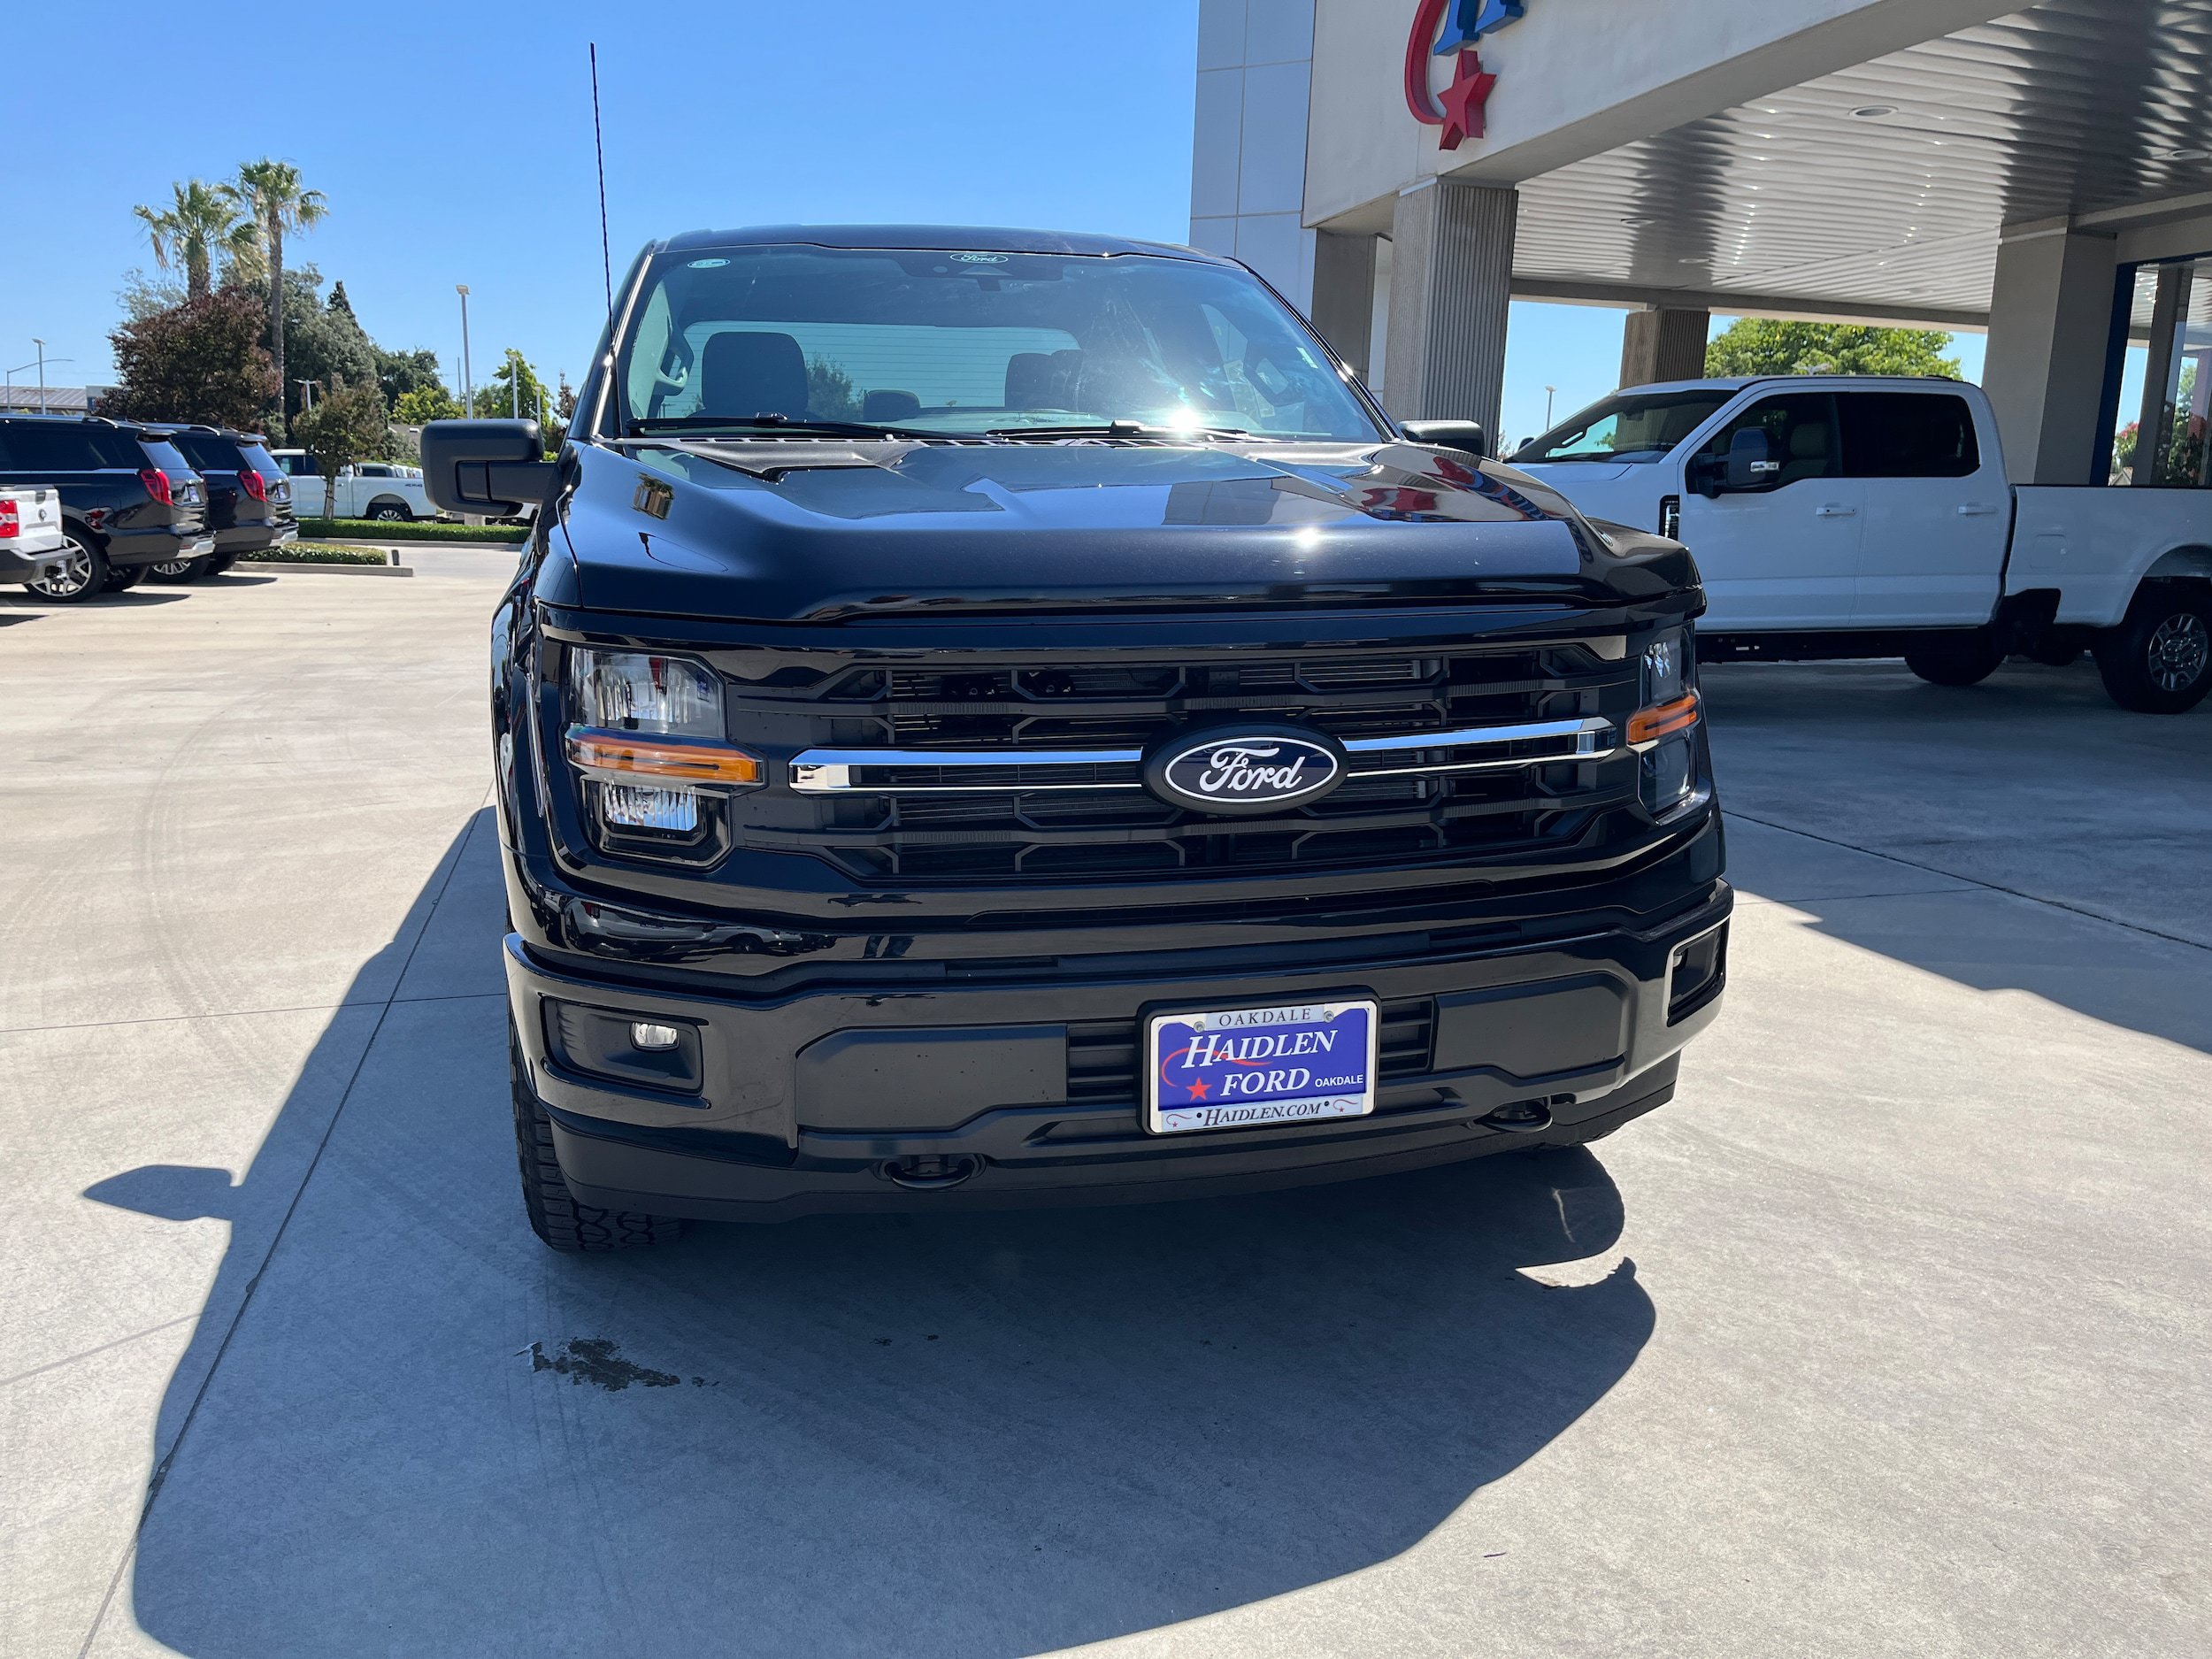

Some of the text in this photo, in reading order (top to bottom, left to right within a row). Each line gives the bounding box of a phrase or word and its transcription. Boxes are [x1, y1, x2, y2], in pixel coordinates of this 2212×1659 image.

[1199, 747, 1305, 792] Ford
[1218, 1008, 1311, 1026] OAKDALE
[1181, 1030, 1338, 1069] HAIDLEN
[1219, 1067, 1363, 1096] FORD OAKDALE
[1202, 1102, 1322, 1126] HAIDLEN.COM
